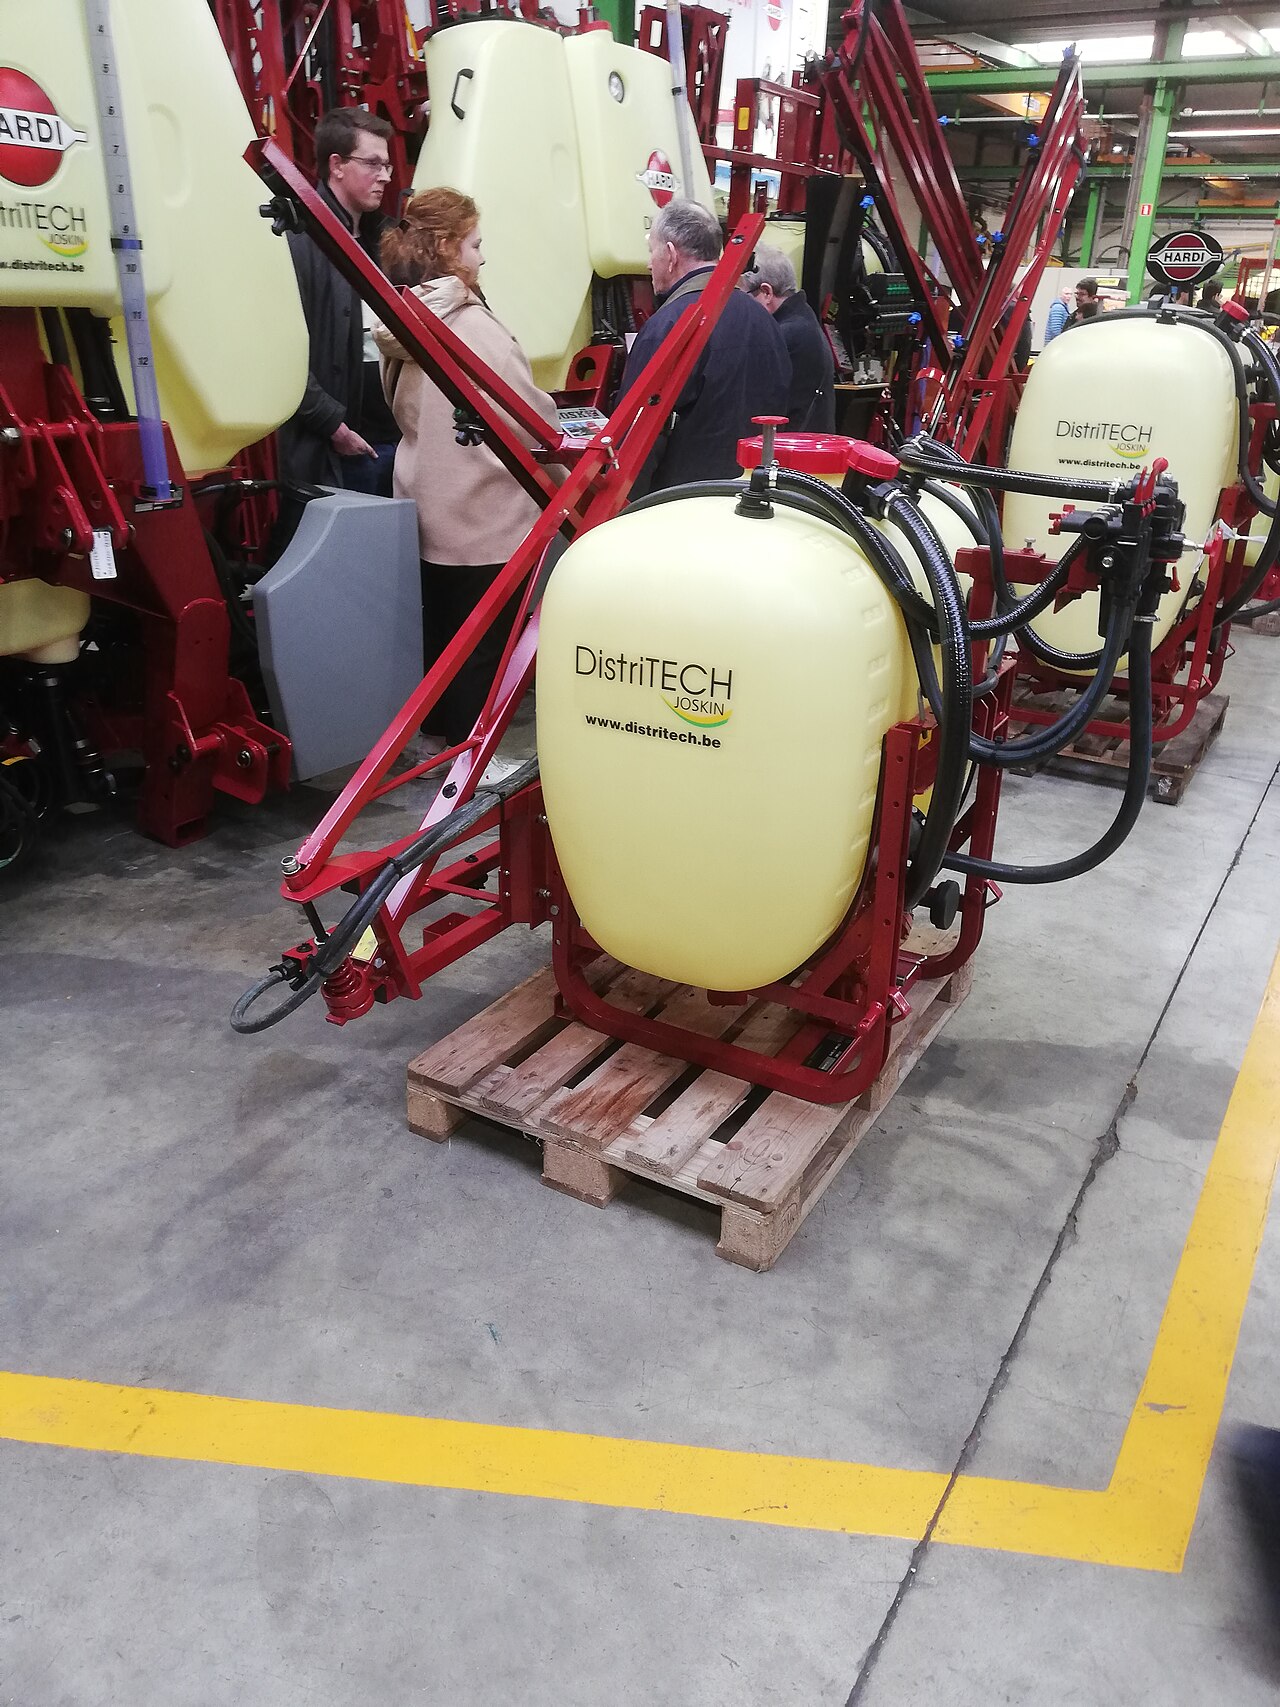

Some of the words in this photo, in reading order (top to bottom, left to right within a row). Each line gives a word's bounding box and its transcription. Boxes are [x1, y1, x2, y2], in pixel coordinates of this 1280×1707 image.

[102, 63, 110, 74] 5
[1163, 252, 1206, 263] HARDI
[126, 263, 137, 273] 10
[132, 310, 143, 320] 11
[137, 356, 149, 366] 12
[1056, 420, 1153, 443] DistriTECH
[1116, 442, 1147, 452] JOSKIN
[1058, 458, 1141, 470] www.distritech.be
[575, 645, 733, 700] DistriTECH
[674, 696, 725, 716] JOSKIN
[585, 714, 722, 748] www.distritech.be
